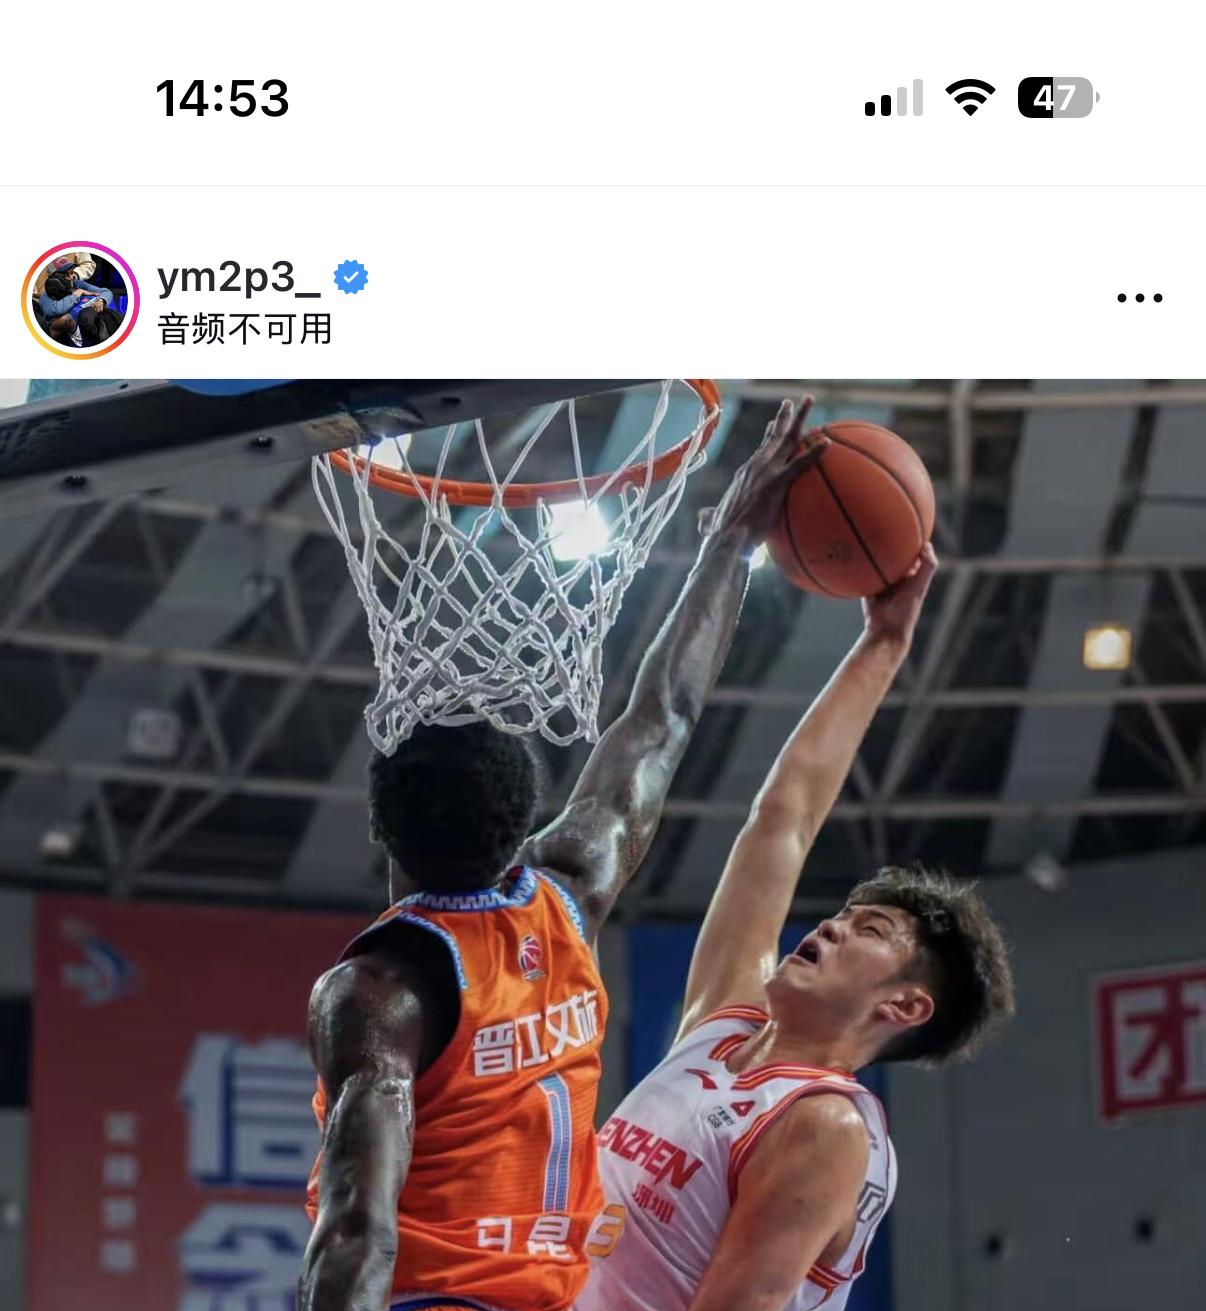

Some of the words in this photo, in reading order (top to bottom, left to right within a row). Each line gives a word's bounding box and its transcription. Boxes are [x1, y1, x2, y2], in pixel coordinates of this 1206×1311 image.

[156, 78, 289, 118] 14:53
[1033, 84, 1076, 111] 47
[157, 260, 322, 300] ym2p3_
[157, 311, 331, 346] 音频不可用
